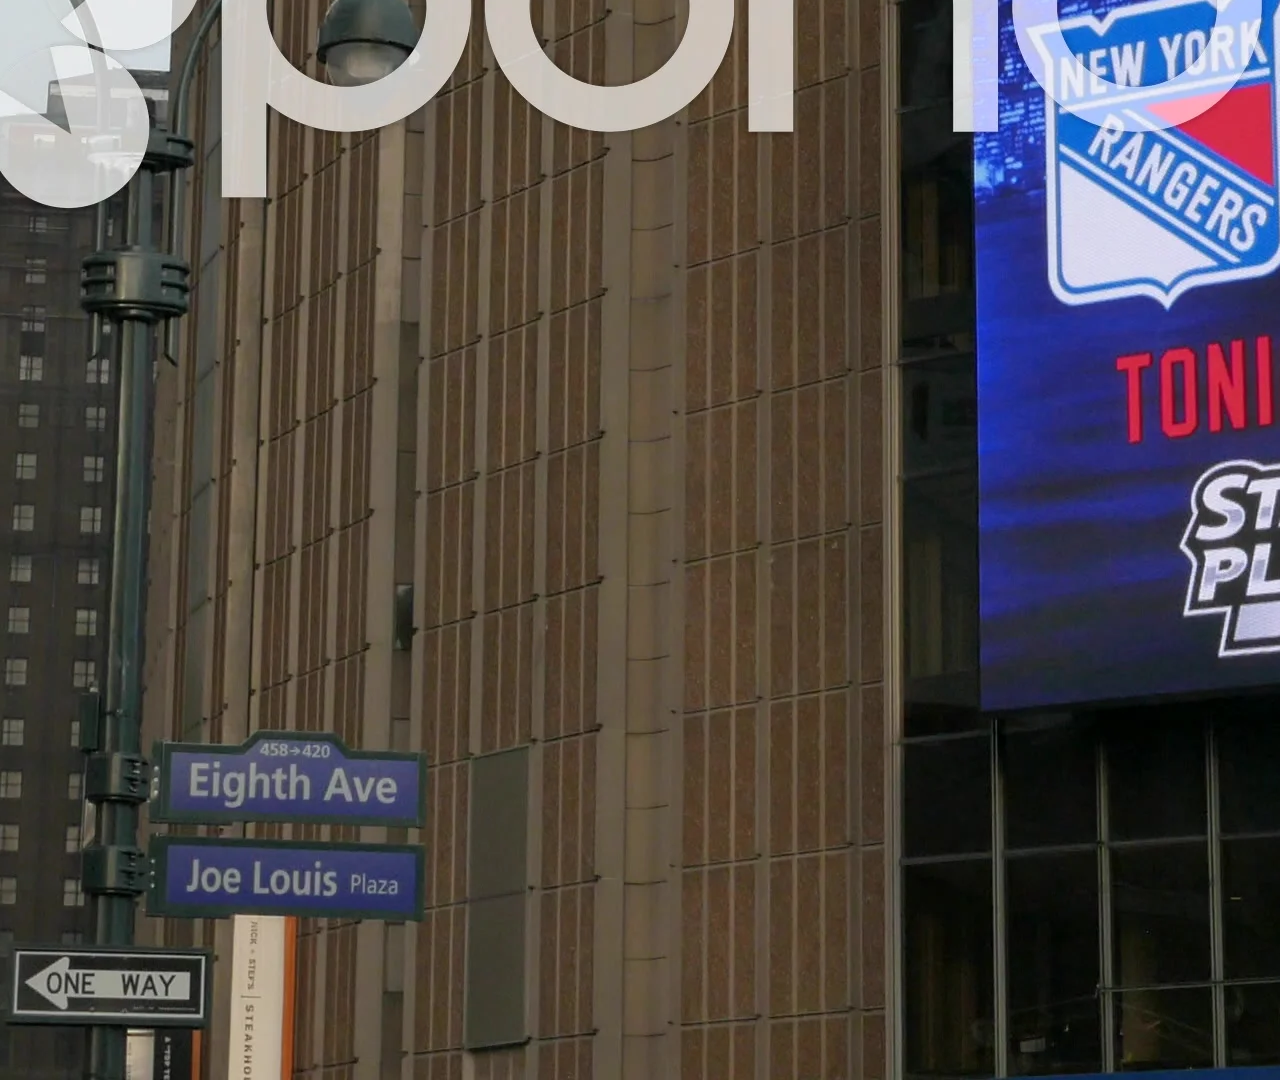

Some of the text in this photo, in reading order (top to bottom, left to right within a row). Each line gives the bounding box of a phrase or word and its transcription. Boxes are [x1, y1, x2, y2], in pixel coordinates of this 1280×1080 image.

[1059, 18, 1268, 102] NEW YORK
[1087, 112, 1268, 253] RANGERS
[189, 761, 398, 809] Eighth Ave
[186, 859, 399, 897] Joe Louis Plaza
[46, 972, 176, 997] ONE WAY
[243, 1004, 254, 1080] STEAKHO
